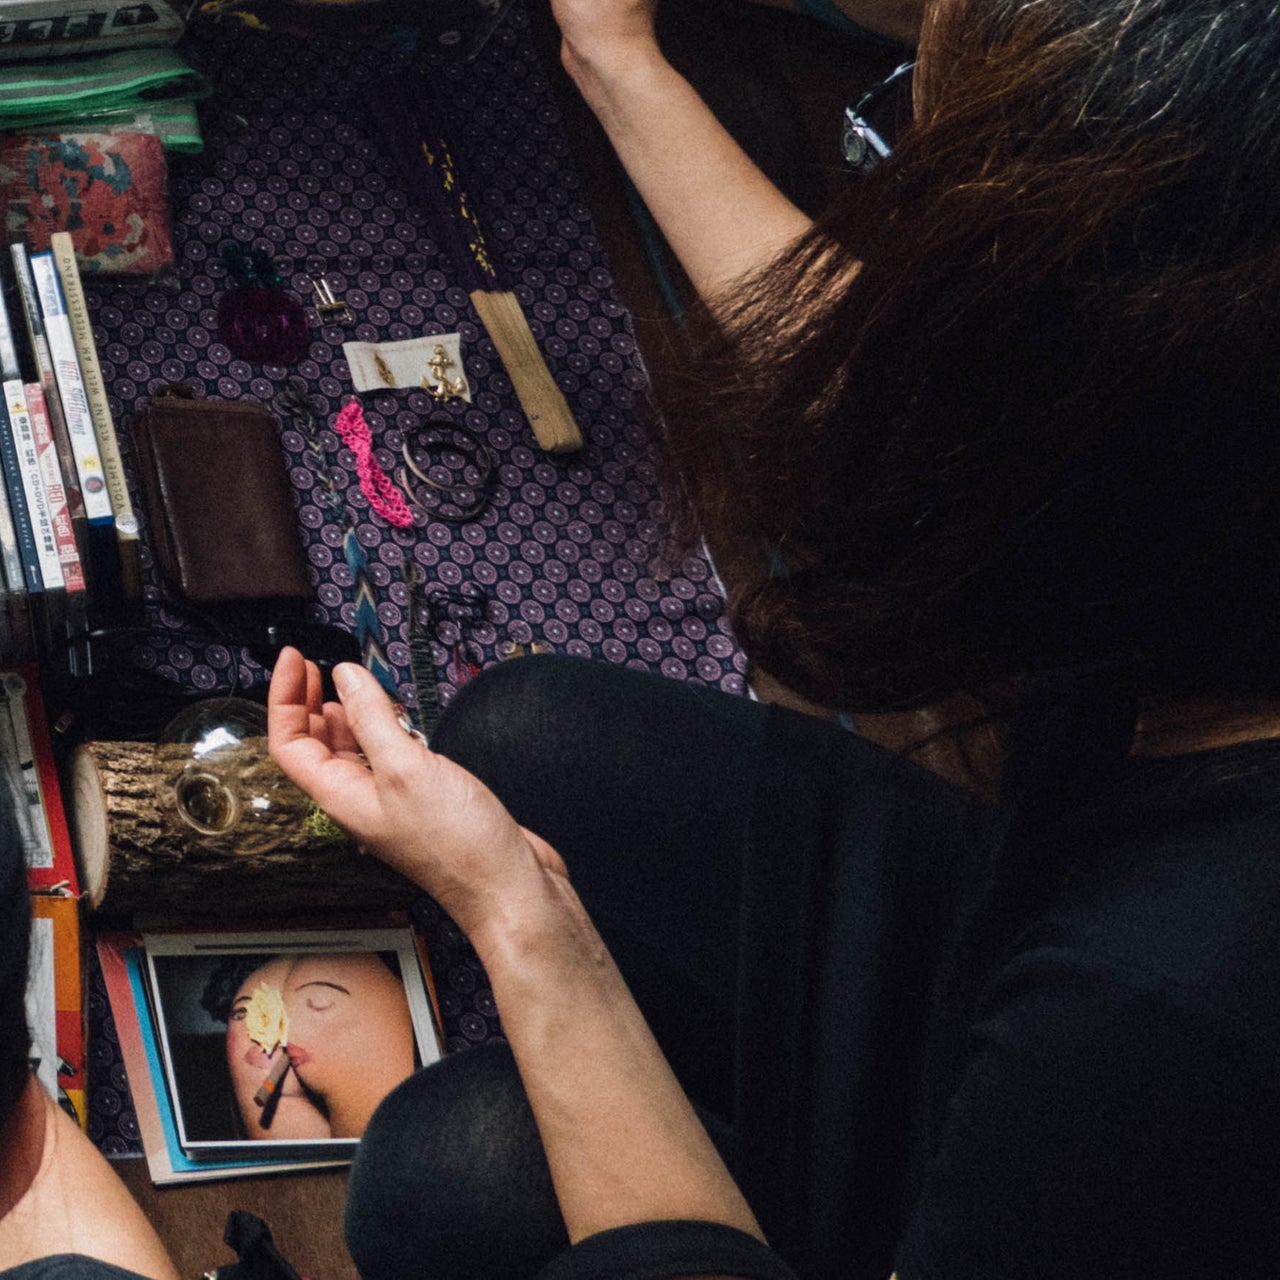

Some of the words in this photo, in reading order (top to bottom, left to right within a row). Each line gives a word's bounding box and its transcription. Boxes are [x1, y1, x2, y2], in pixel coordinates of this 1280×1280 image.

[63, 258, 90, 341] MEERESSTRAND
[81, 345, 94, 363] AM
[86, 368, 101, 396] WELT
[93, 402, 111, 443] KLEINE
[47, 483, 65, 504] RED
[105, 456, 125, 509] VOLLMER
